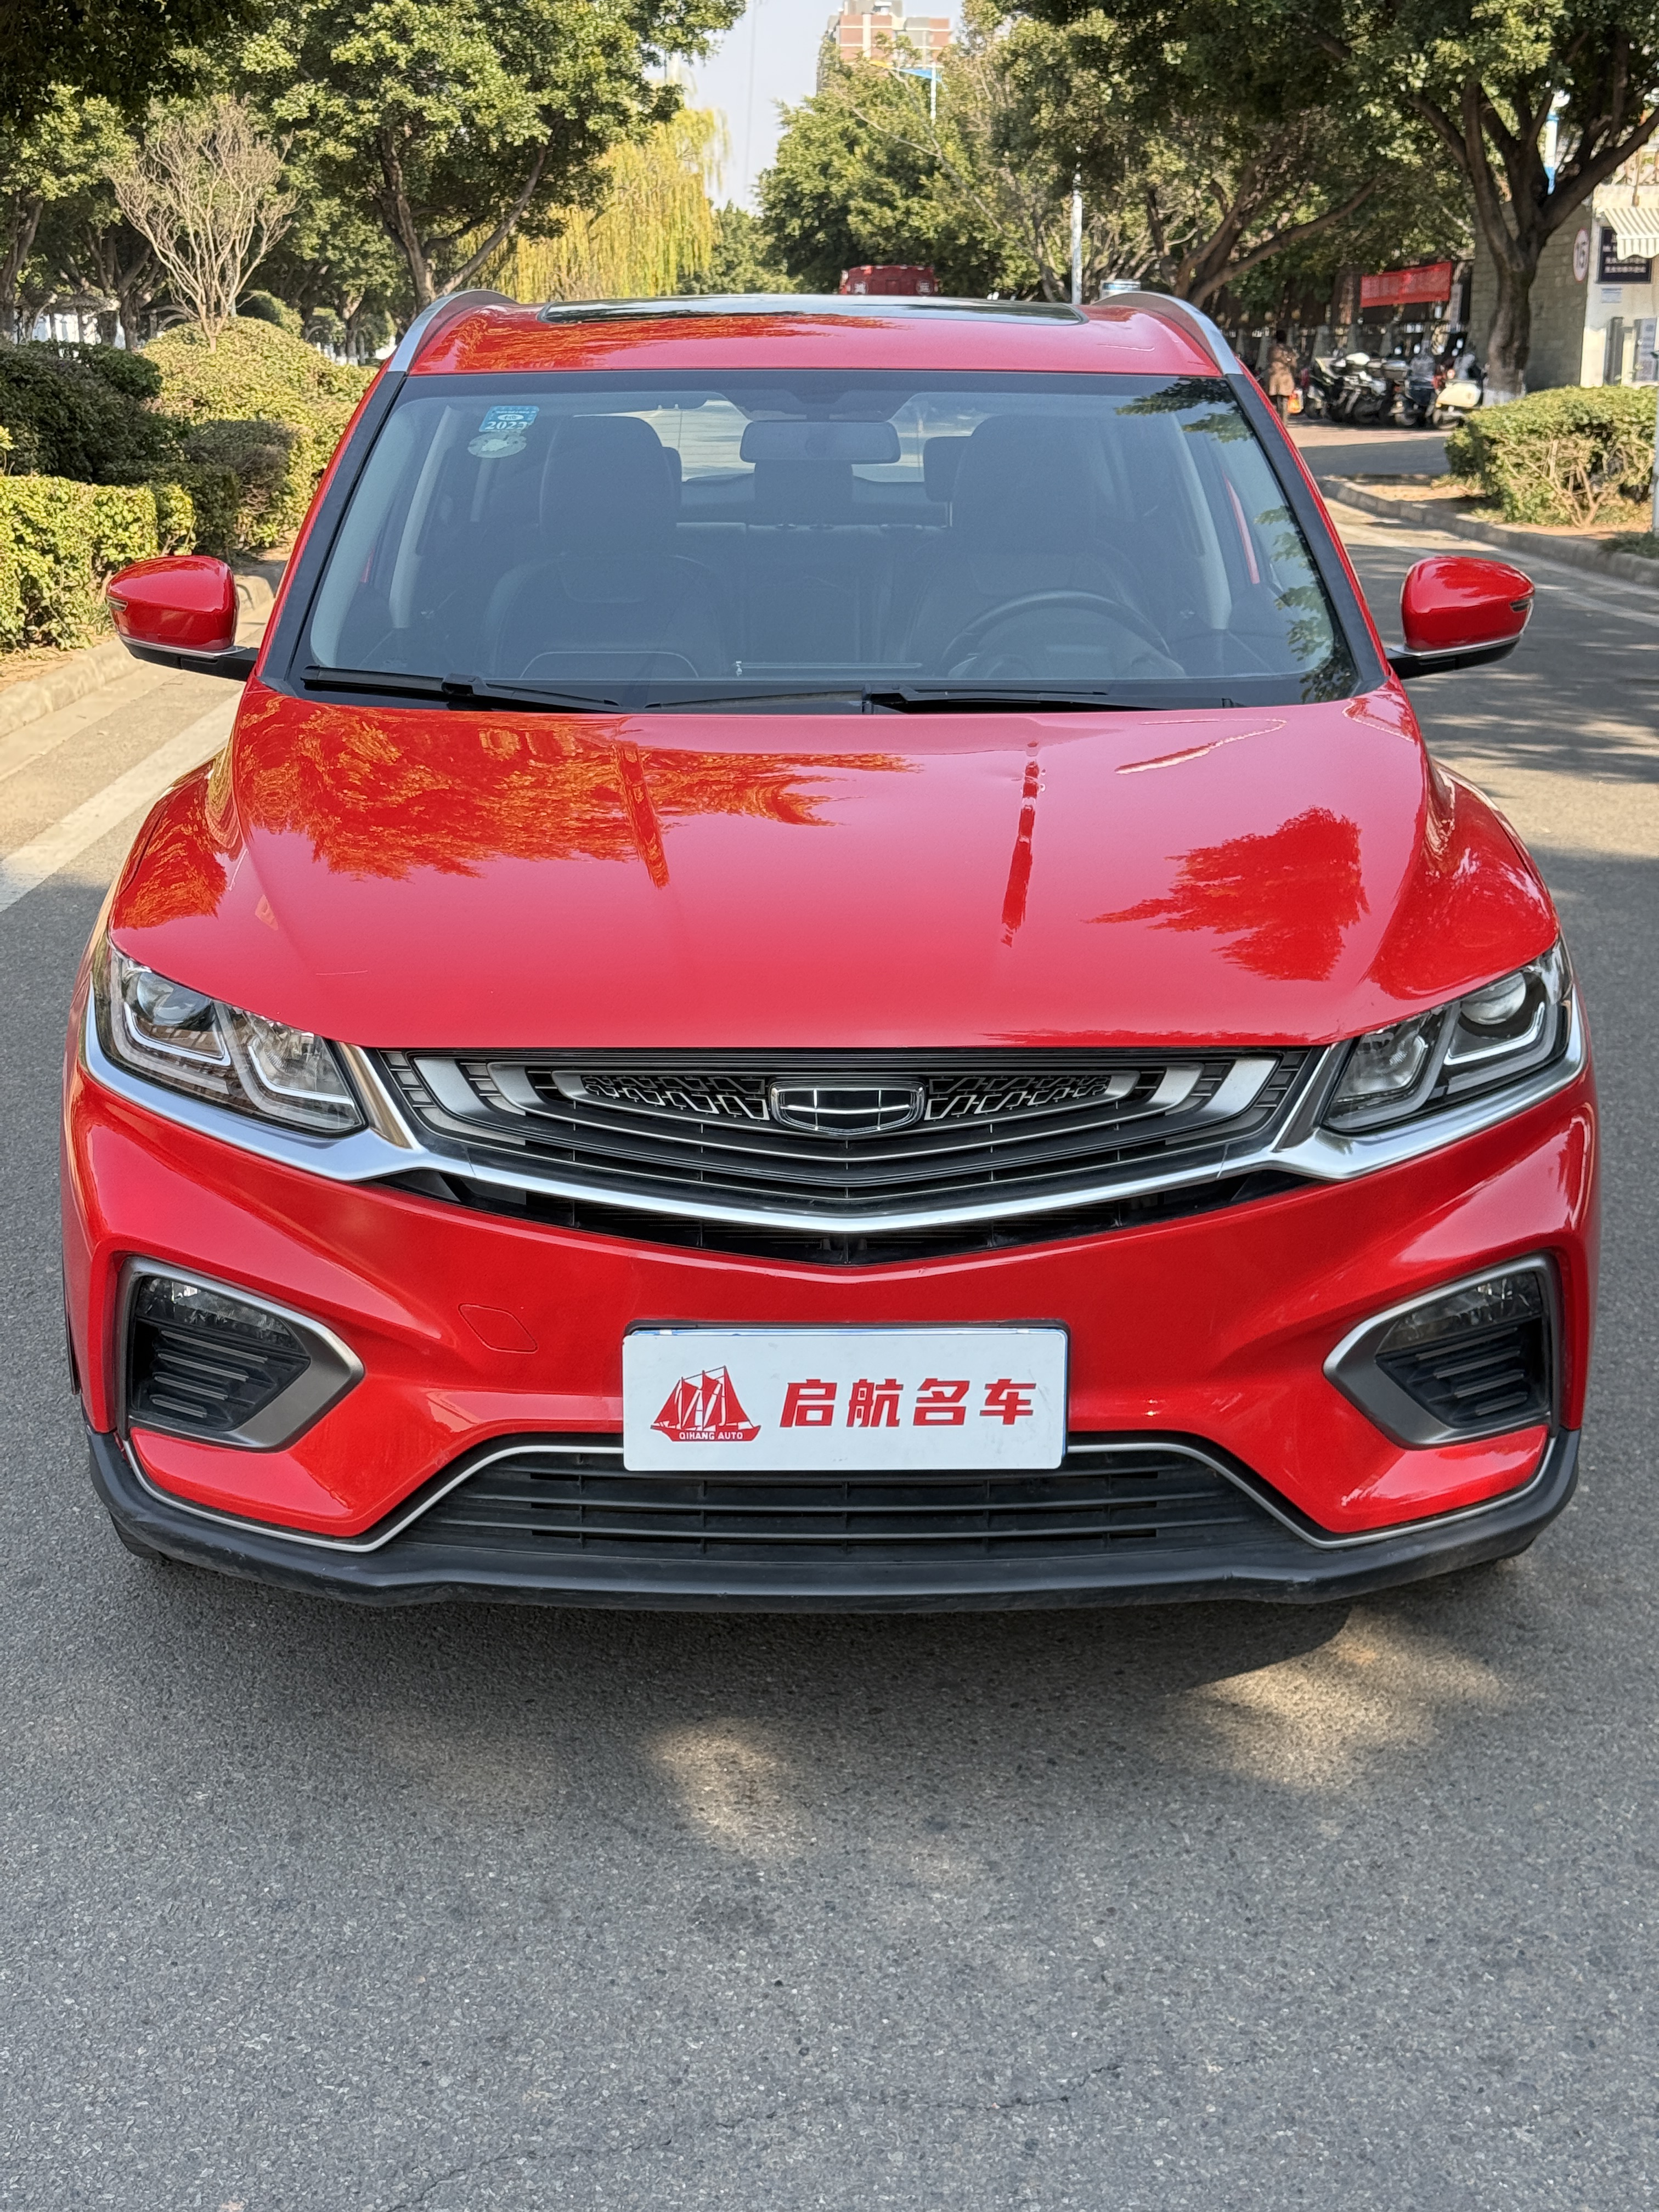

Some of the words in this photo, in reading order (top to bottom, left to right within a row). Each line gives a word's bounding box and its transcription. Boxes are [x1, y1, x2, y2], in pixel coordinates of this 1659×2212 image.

[779, 1378, 1036, 1427] 启航名车
[679, 1431, 715, 1440] QIHANG
[718, 1431, 743, 1440] AUTO
